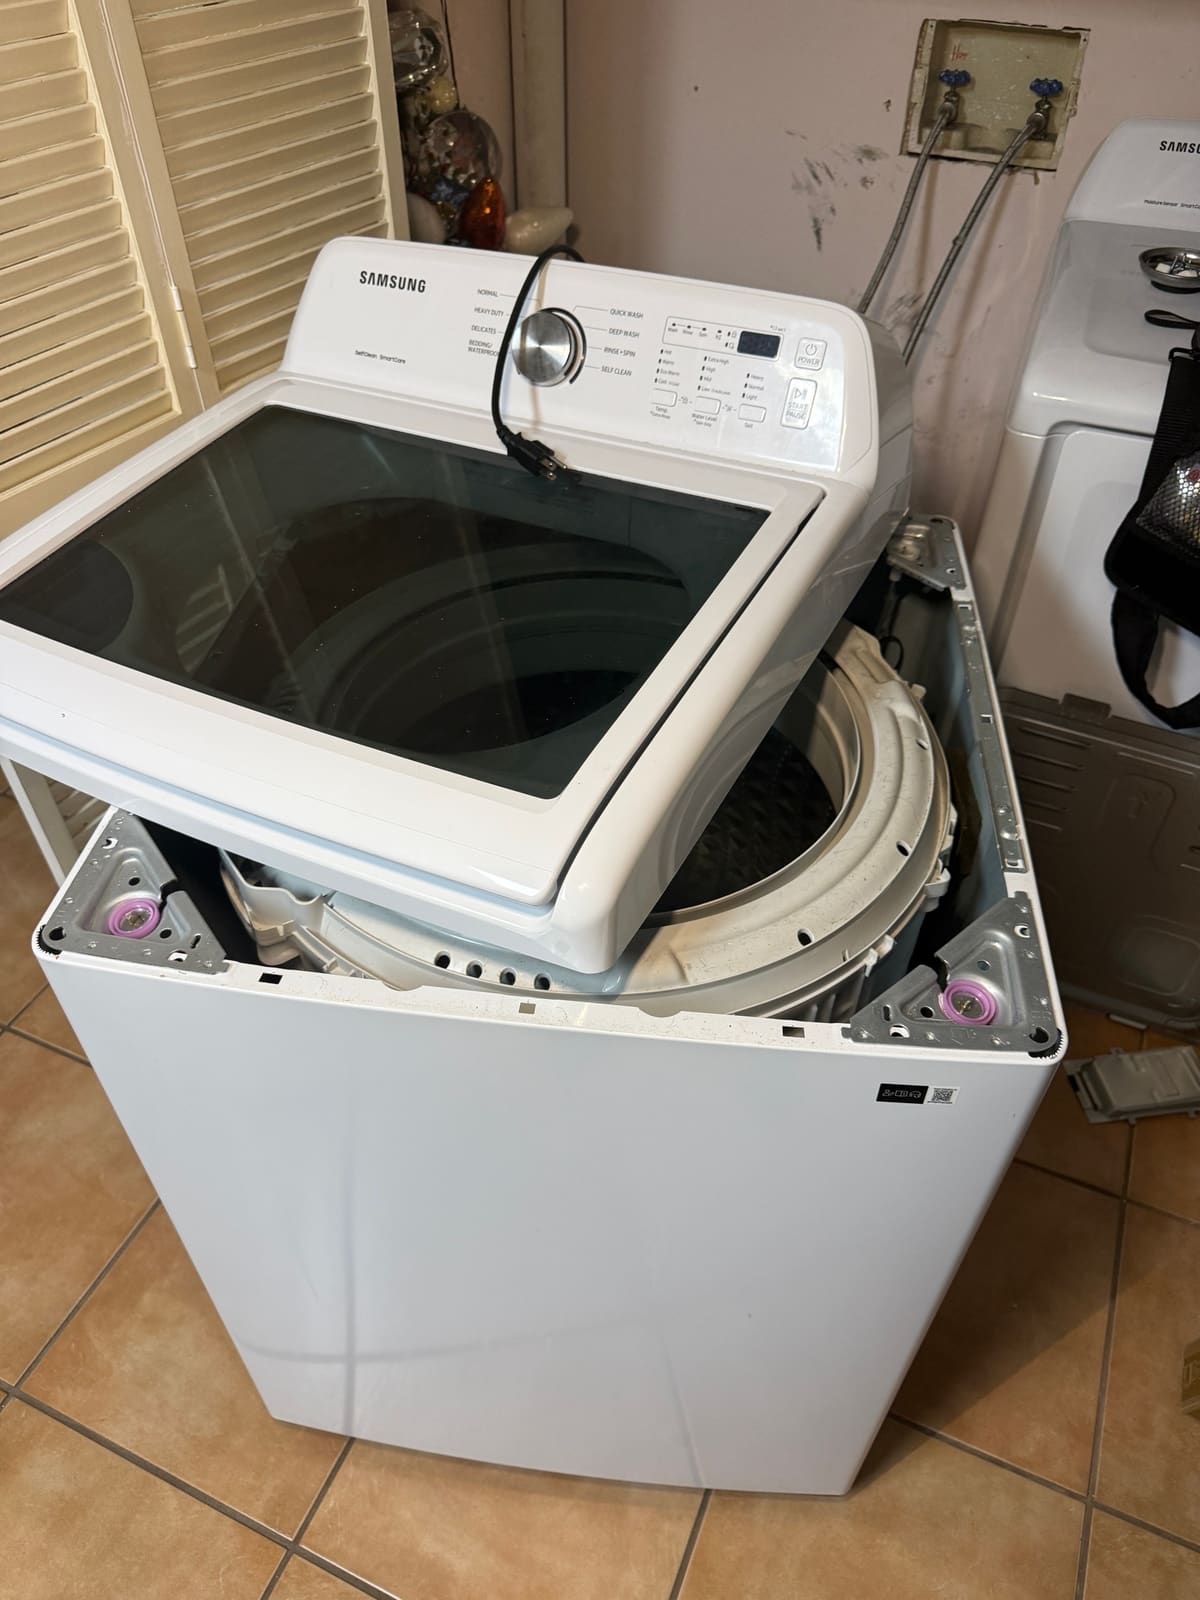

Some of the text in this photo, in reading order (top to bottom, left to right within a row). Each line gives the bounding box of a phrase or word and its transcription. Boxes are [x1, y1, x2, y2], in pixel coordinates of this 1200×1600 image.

[359, 270, 427, 293] SAMSUNG
[477, 289, 498, 298] NORMAL
[474, 307, 504, 318] HEAVY DUTY
[610, 308, 644, 319] QUICK WASH
[471, 324, 497, 335] DELICATES
[608, 328, 623, 336] DEEP
[797, 356, 820, 366] POWER
[601, 365, 633, 377] SELF CLEAN
[786, 410, 806, 418] PAUSE
